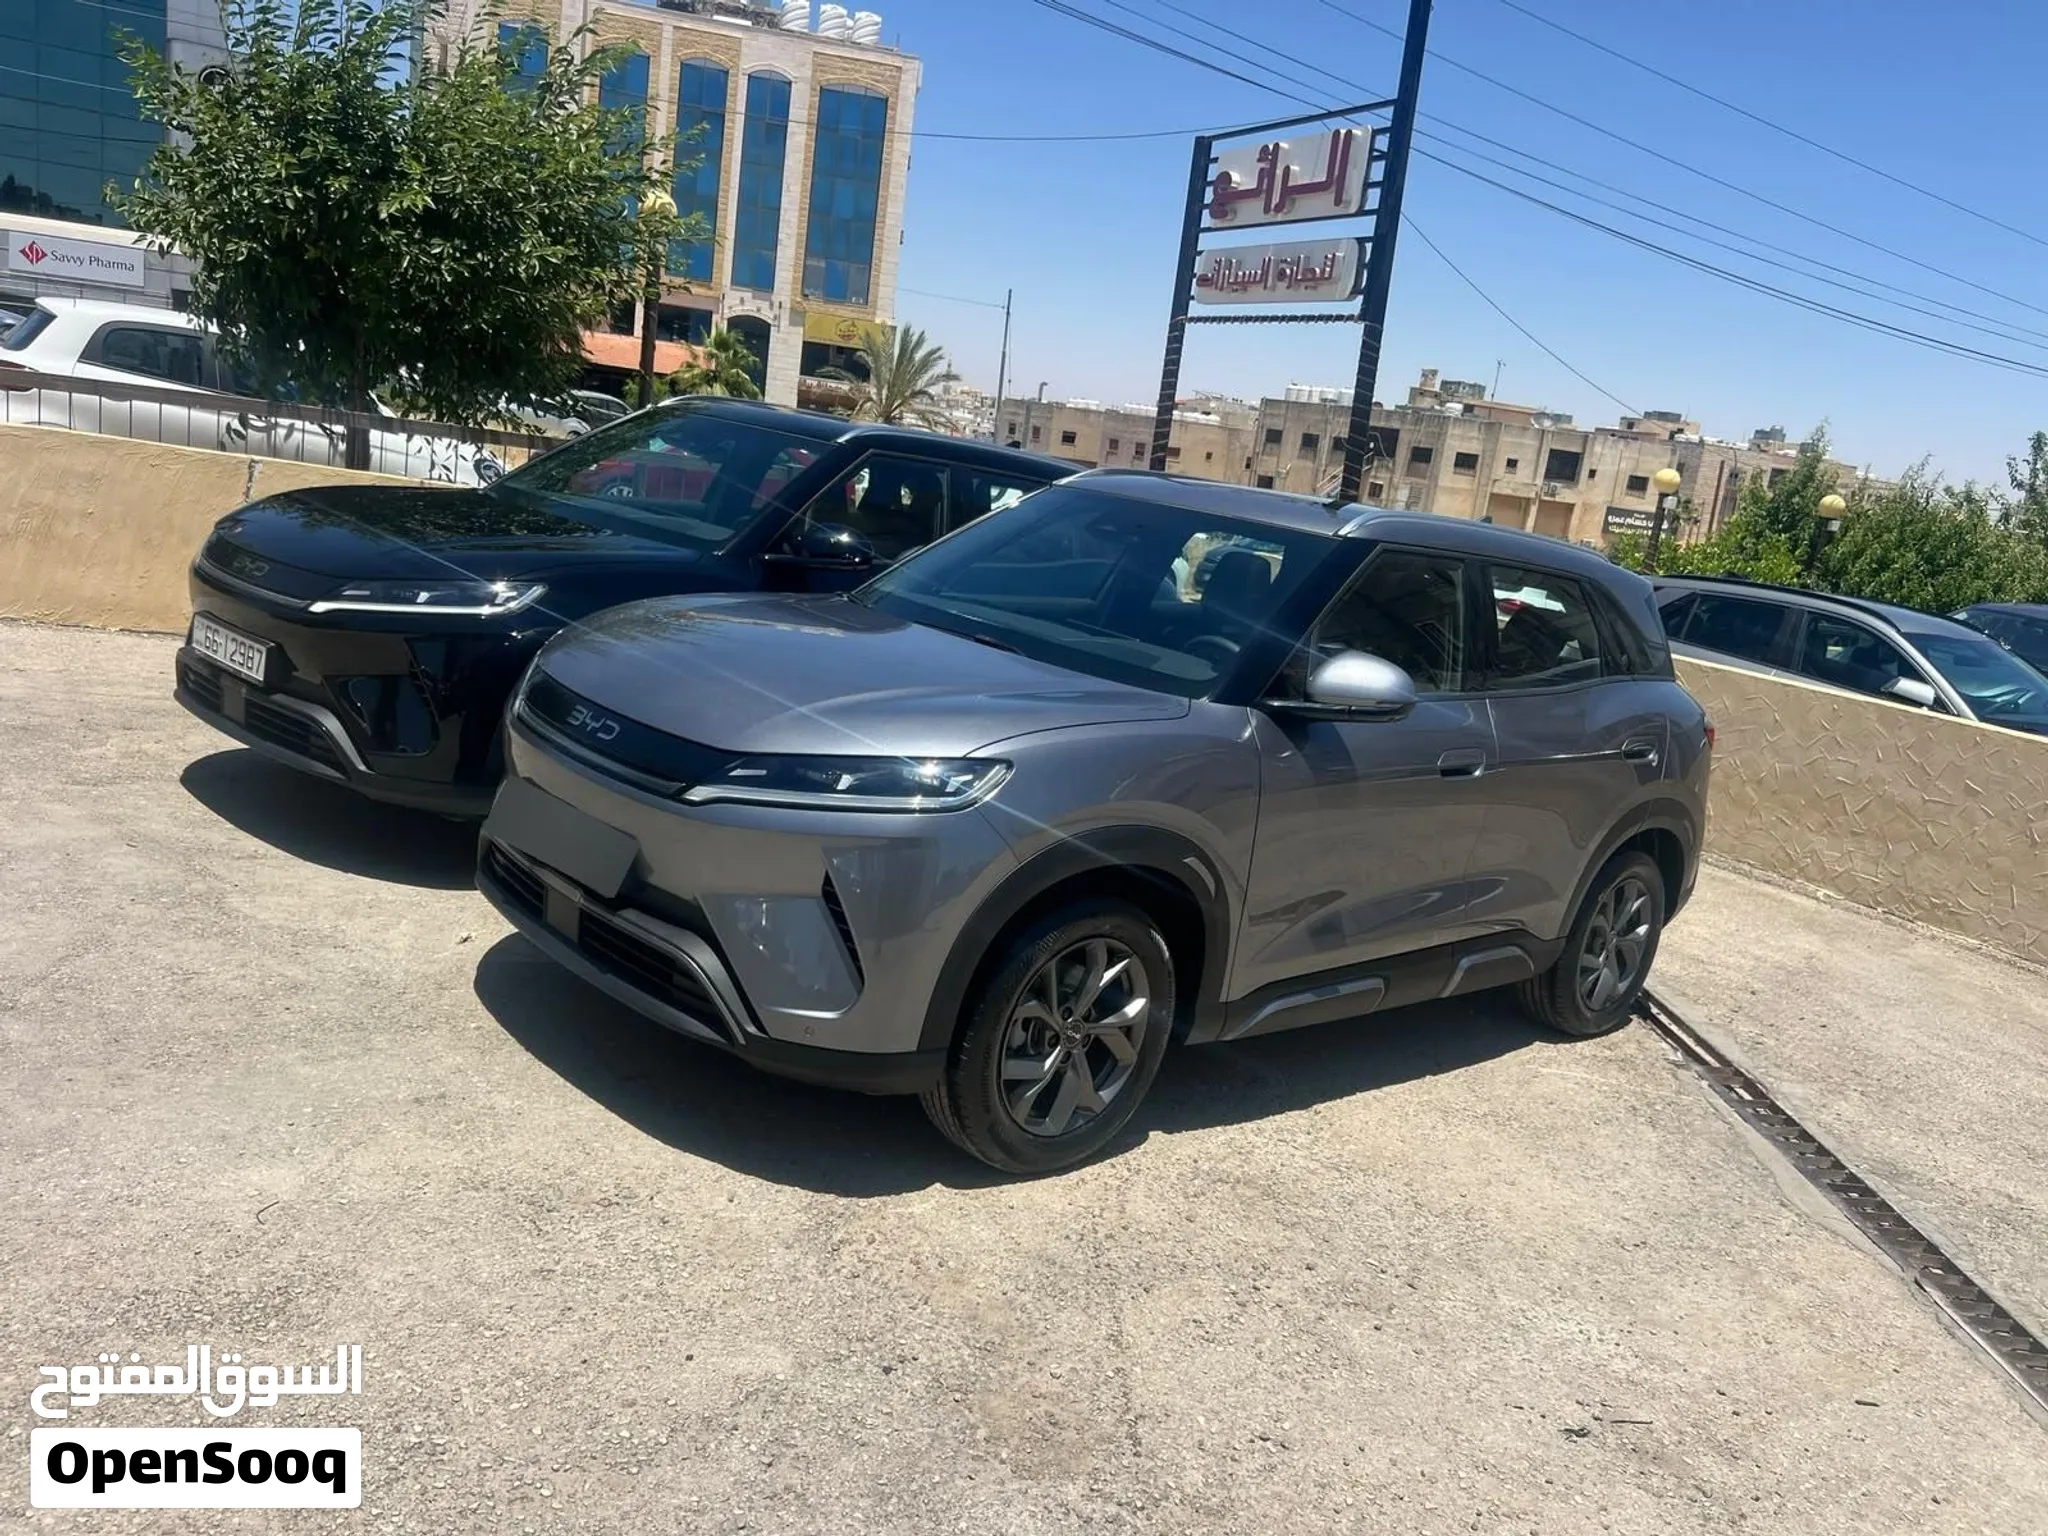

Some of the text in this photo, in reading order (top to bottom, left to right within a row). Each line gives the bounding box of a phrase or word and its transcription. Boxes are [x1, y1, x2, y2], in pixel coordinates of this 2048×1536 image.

[1209, 129, 1353, 220] الرائع
[50, 249, 136, 273] Savvy Pharma
[1196, 252, 1337, 293] لتجارة السيارات
[566, 704, 620, 740] BYD
